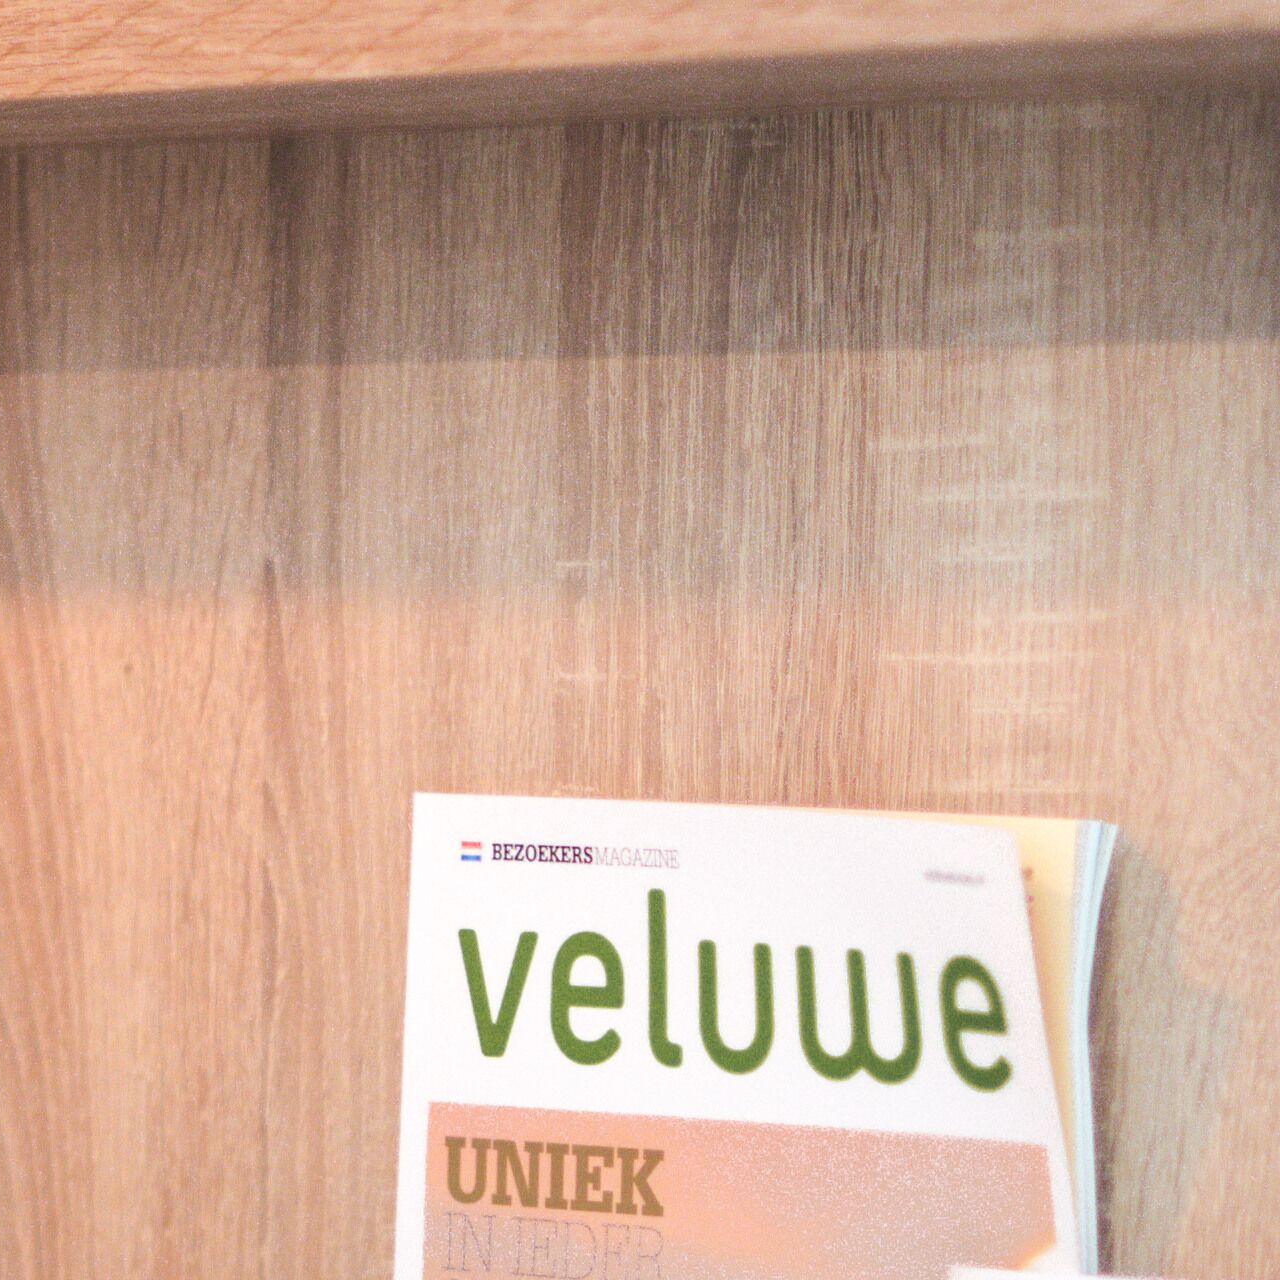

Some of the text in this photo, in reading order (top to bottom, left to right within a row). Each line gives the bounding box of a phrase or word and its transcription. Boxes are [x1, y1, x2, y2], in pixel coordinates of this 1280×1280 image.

[458, 888, 1012, 1092] veluwe
[444, 1135, 665, 1217] UNIEK
[442, 1212, 497, 1273] IN
